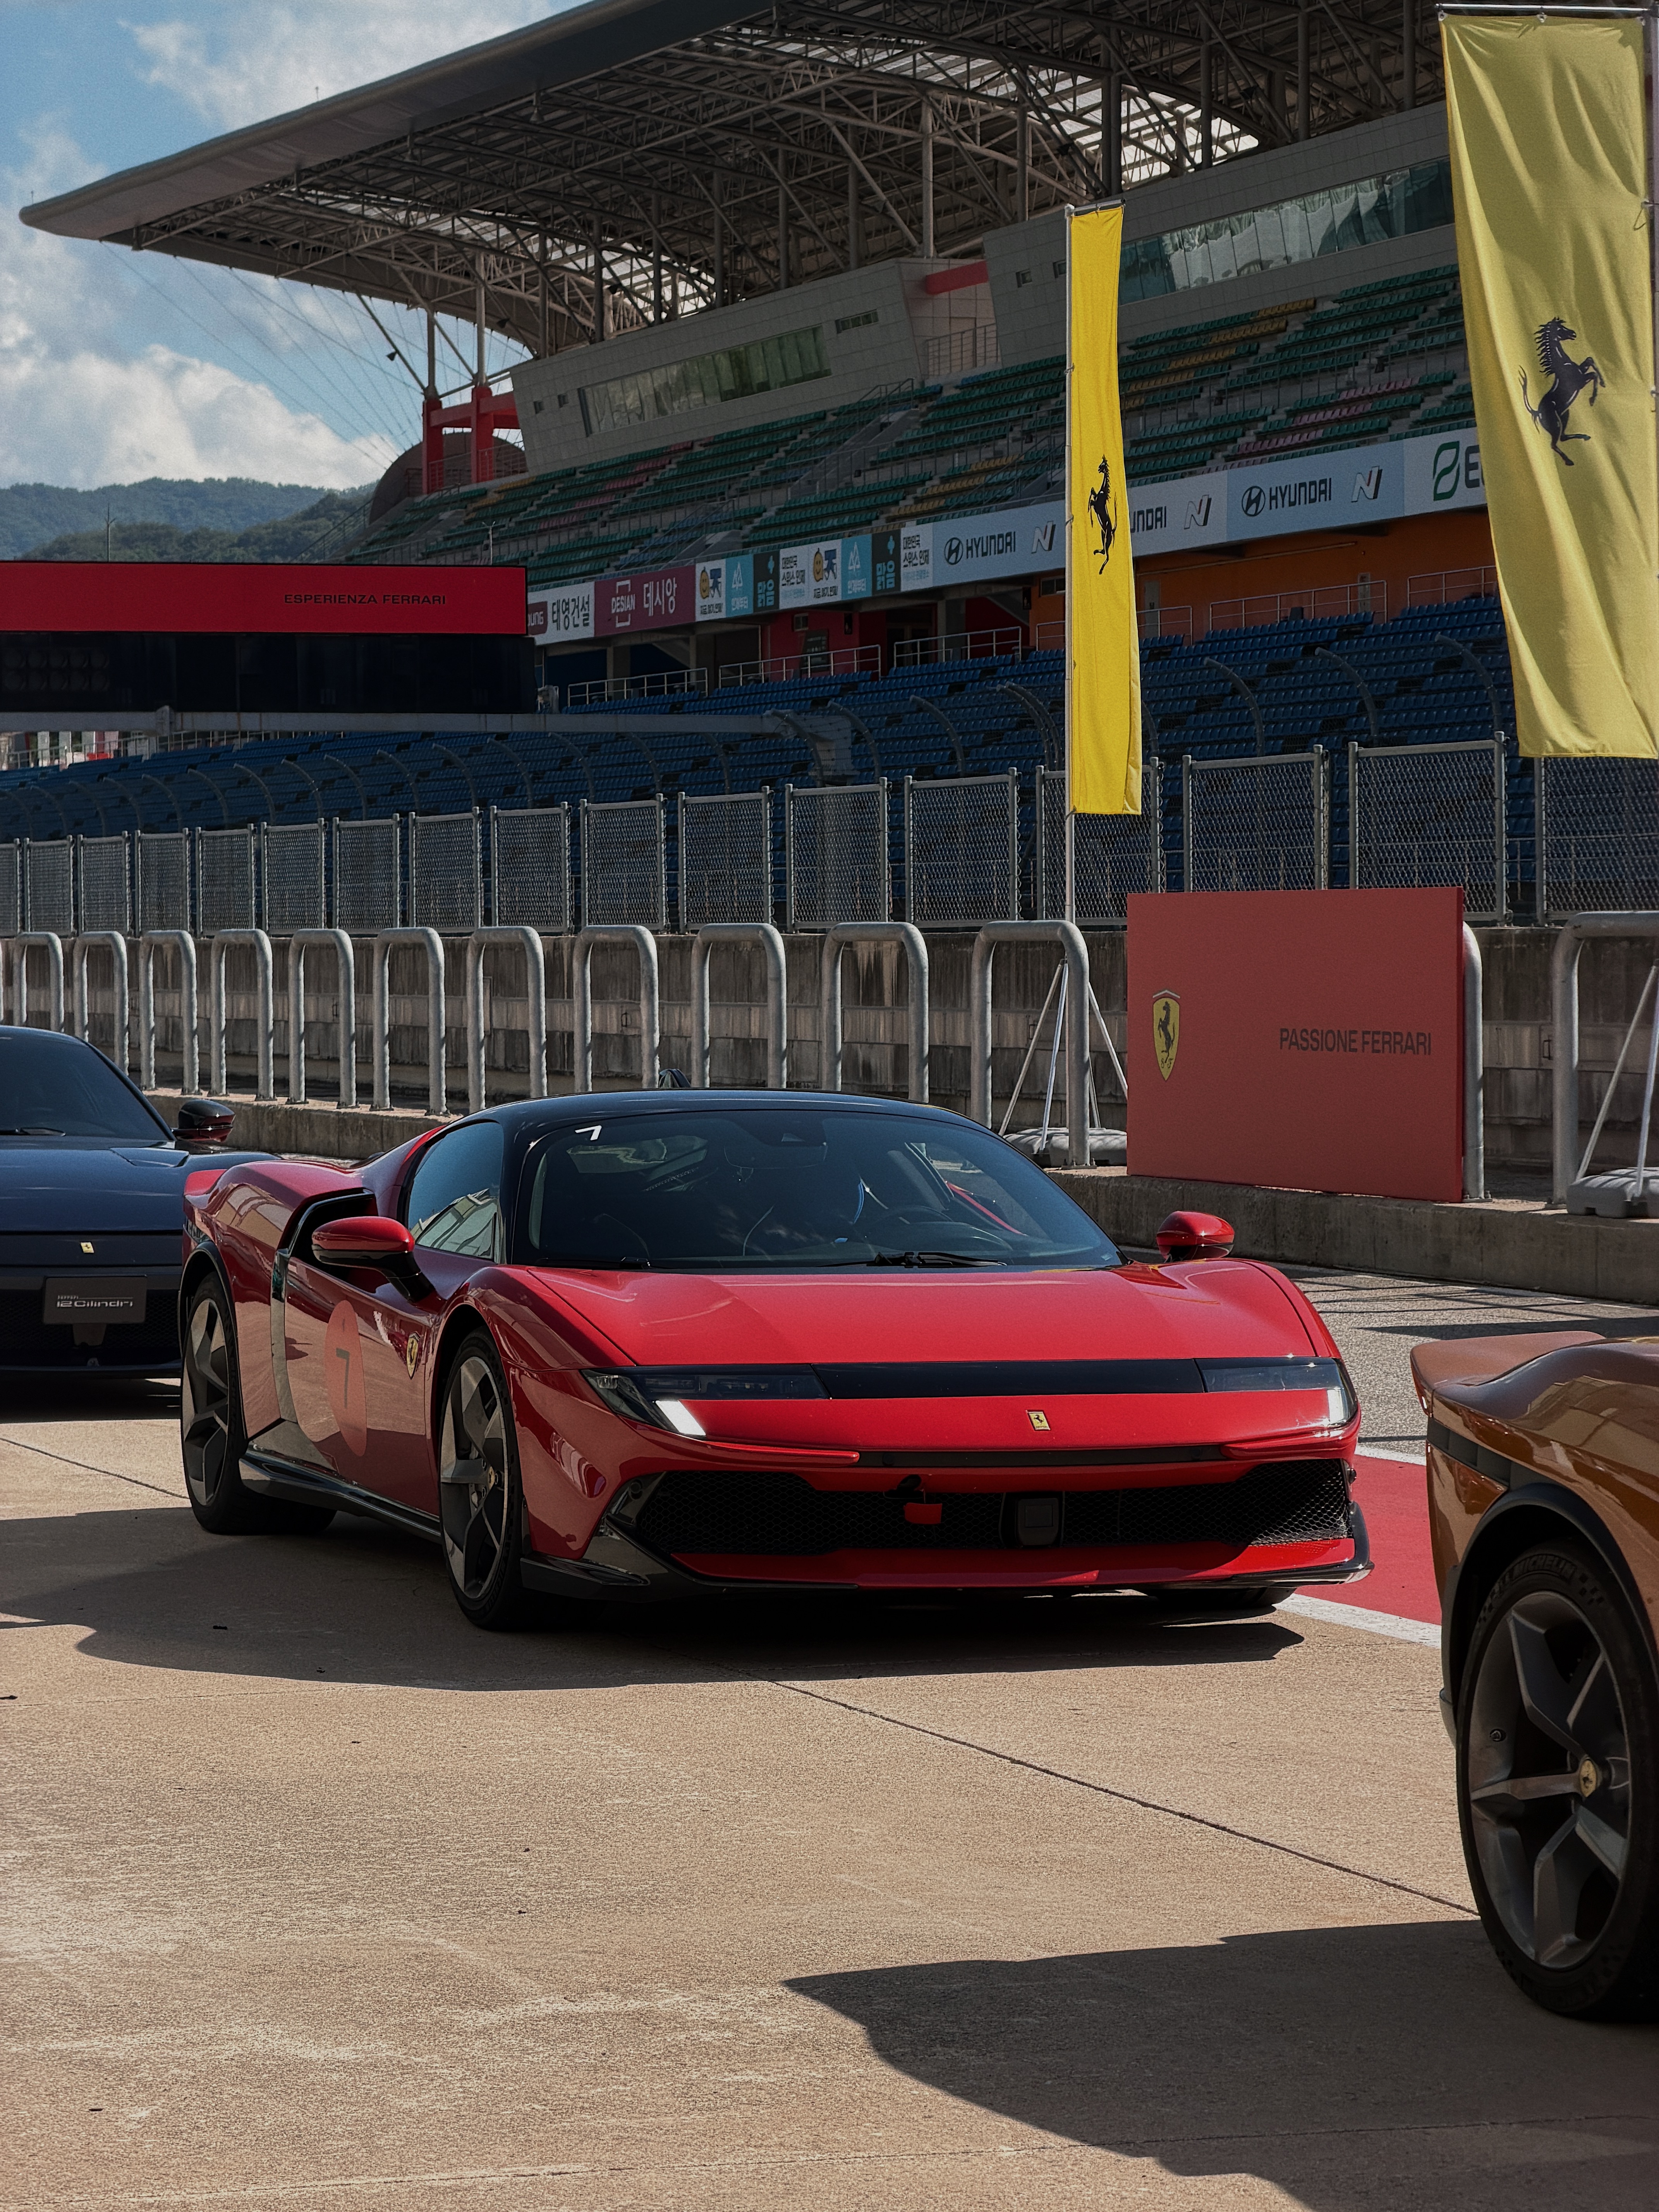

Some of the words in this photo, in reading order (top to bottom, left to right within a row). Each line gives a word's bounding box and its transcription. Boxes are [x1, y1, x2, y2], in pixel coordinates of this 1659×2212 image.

[1465, 444, 1486, 489] E
[1269, 477, 1332, 509] HYUNDAI
[903, 534, 921, 550] 대한민국
[966, 531, 1016, 559] HYUNDAI
[782, 555, 797, 569] 대한민국
[903, 551, 918, 568] 스위스
[919, 549, 929, 565] 인제
[781, 570, 795, 586] 스위스
[796, 570, 805, 584] 인제
[284, 594, 377, 604] ESPERIENZA
[383, 595, 446, 605] FERRARI
[611, 594, 636, 615] DESIAN
[643, 577, 678, 617] 데시앙
[552, 594, 590, 631] 태영건설
[1279, 1027, 1358, 1053] PASSIONE
[1362, 1030, 1431, 1056] FERRARI
[335, 1347, 350, 1409] 7
